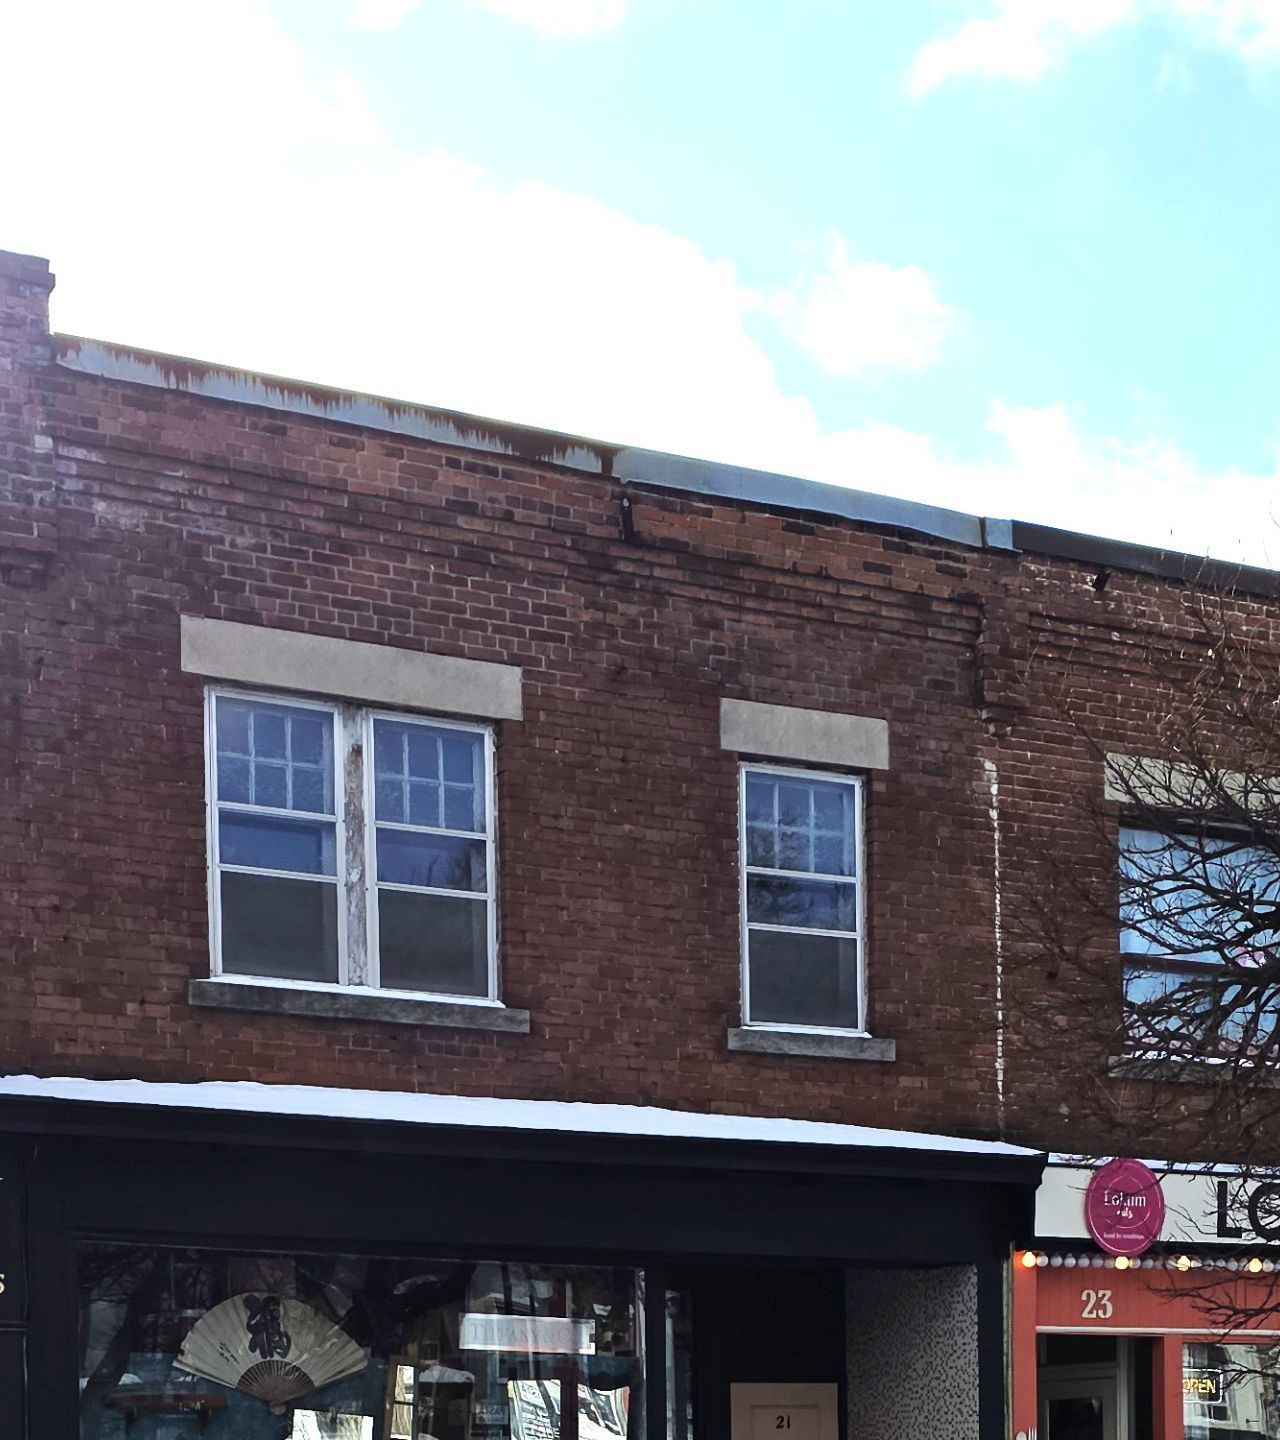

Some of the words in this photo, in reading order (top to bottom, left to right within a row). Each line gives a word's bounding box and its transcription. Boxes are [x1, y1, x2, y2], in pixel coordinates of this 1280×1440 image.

[1081, 1289, 1113, 1319] 23
[1182, 1378, 1216, 1394] OPEN
[776, 1414, 791, 1430] 21
